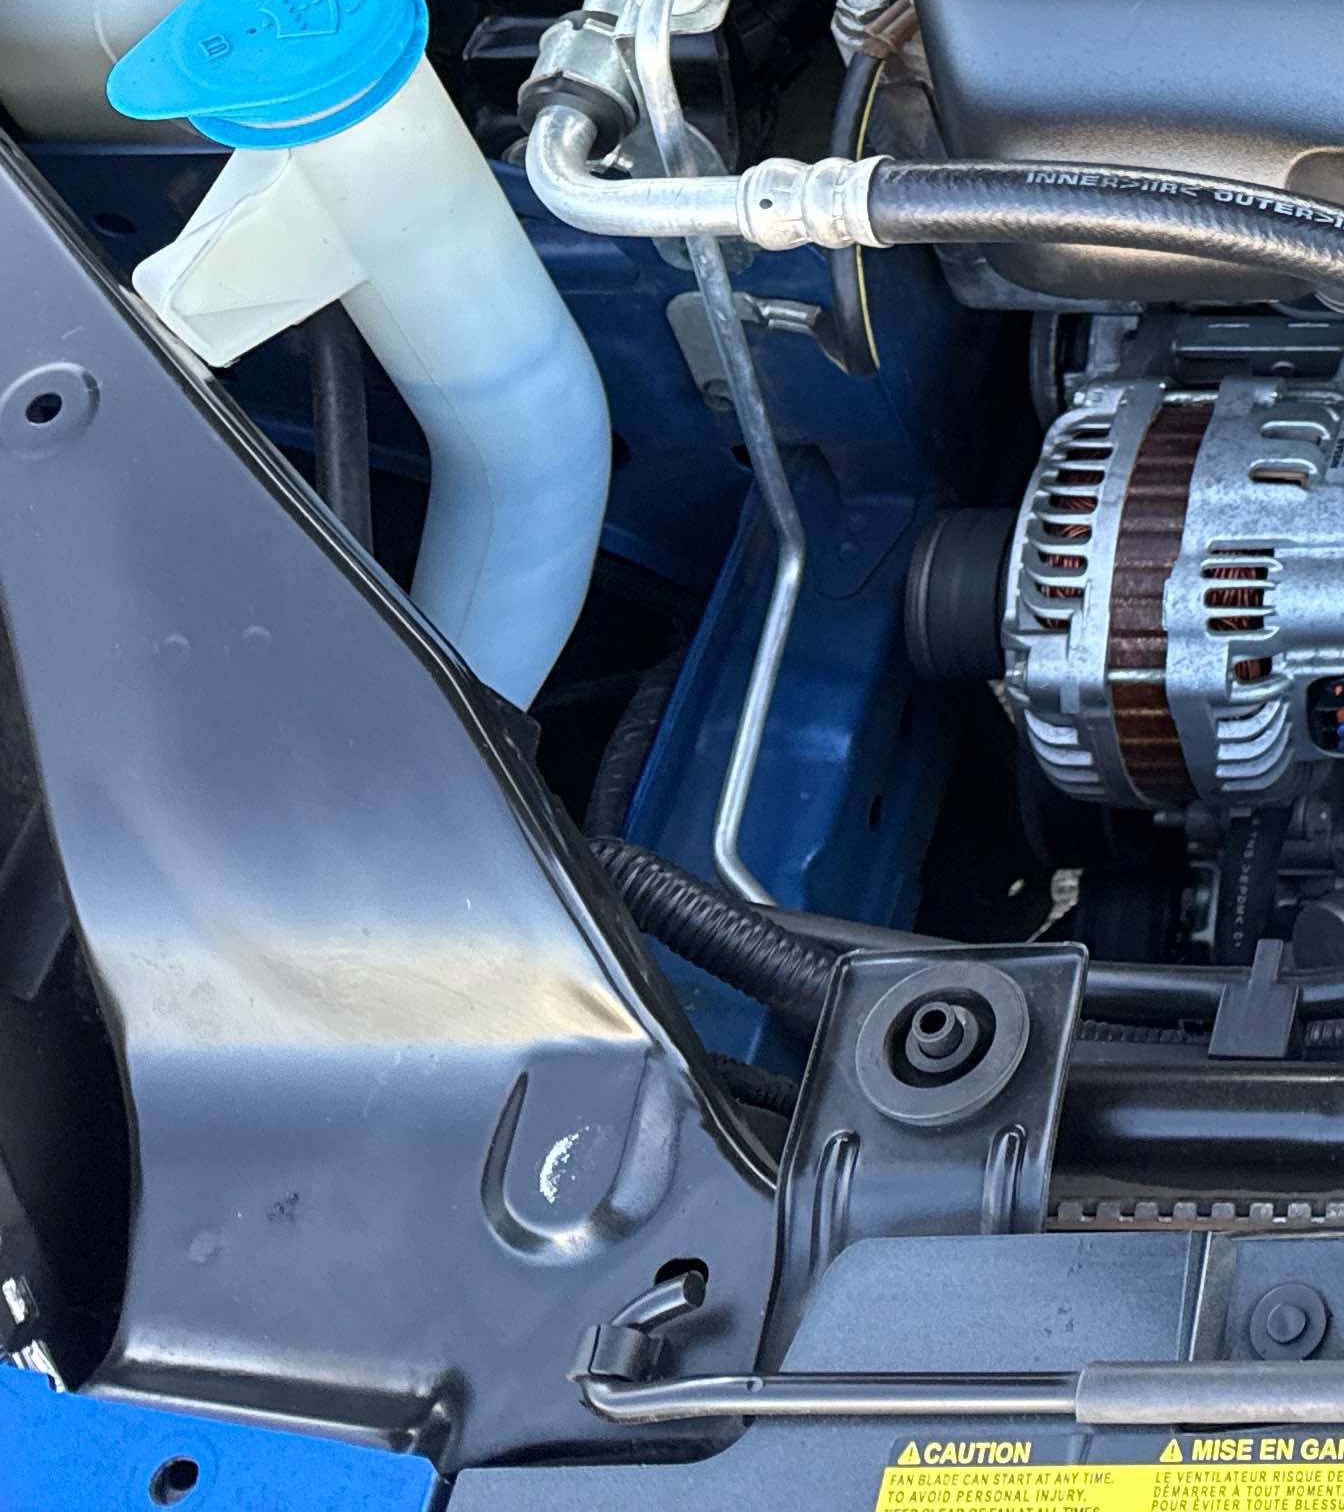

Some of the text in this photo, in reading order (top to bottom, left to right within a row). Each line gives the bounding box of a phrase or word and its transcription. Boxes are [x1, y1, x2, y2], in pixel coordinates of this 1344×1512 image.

[924, 1441, 1031, 1464] CAUTION
[1192, 1439, 1253, 1460] MISE
[1260, 1439, 1294, 1460] EN
[890, 1474, 914, 1486] FAN
[918, 1473, 957, 1485] BLADE
[963, 1473, 988, 1485] CAN
[993, 1473, 1032, 1485] START
[1035, 1472, 1050, 1484] AT
[1054, 1472, 1078, 1484] ANY
[1155, 1471, 1344, 1483] LE VENTILATEUR RISQUE DE
[888, 1491, 904, 1502] TO
[909, 1491, 950, 1502] AVOID
[956, 1490, 1029, 1502] PERSONAL
[1154, 1484, 1226, 1497] DÉMARRER
[1247, 1486, 1279, 1496] TOUT
[1151, 1500, 1187, 1512] POUR
[1193, 1497, 1240, 1511] ÉVITER
[1246, 1499, 1289, 1511] TOUTE
